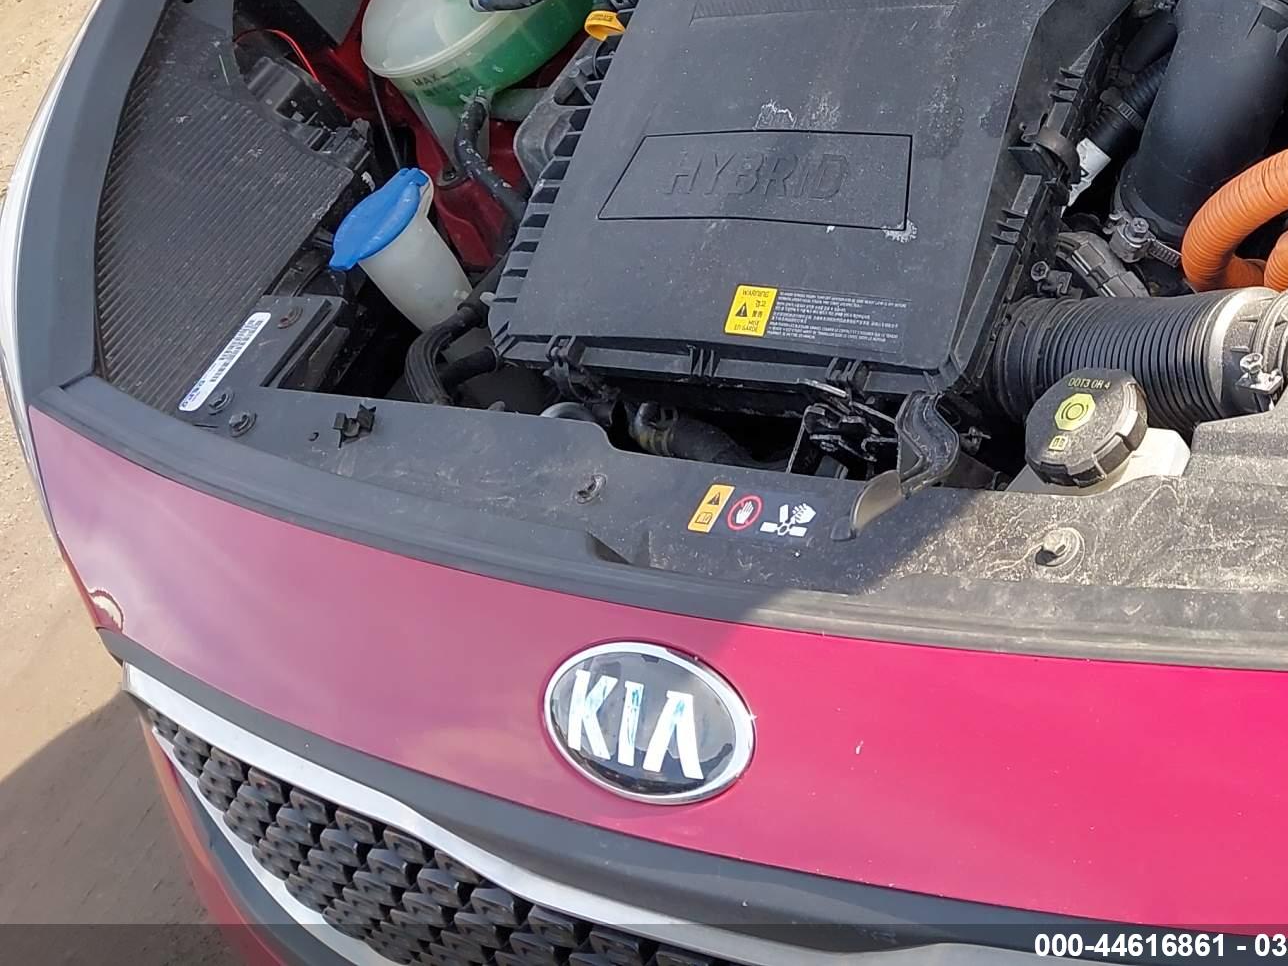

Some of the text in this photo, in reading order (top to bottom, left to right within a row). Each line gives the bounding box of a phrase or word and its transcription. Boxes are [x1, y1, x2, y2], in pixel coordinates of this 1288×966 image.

[412, 73, 440, 87] MAX
[664, 152, 850, 201] HYBRID
[743, 289, 770, 298] WARNING
[1068, 377, 1090, 388] DOT3
[567, 669, 704, 780] KIA
